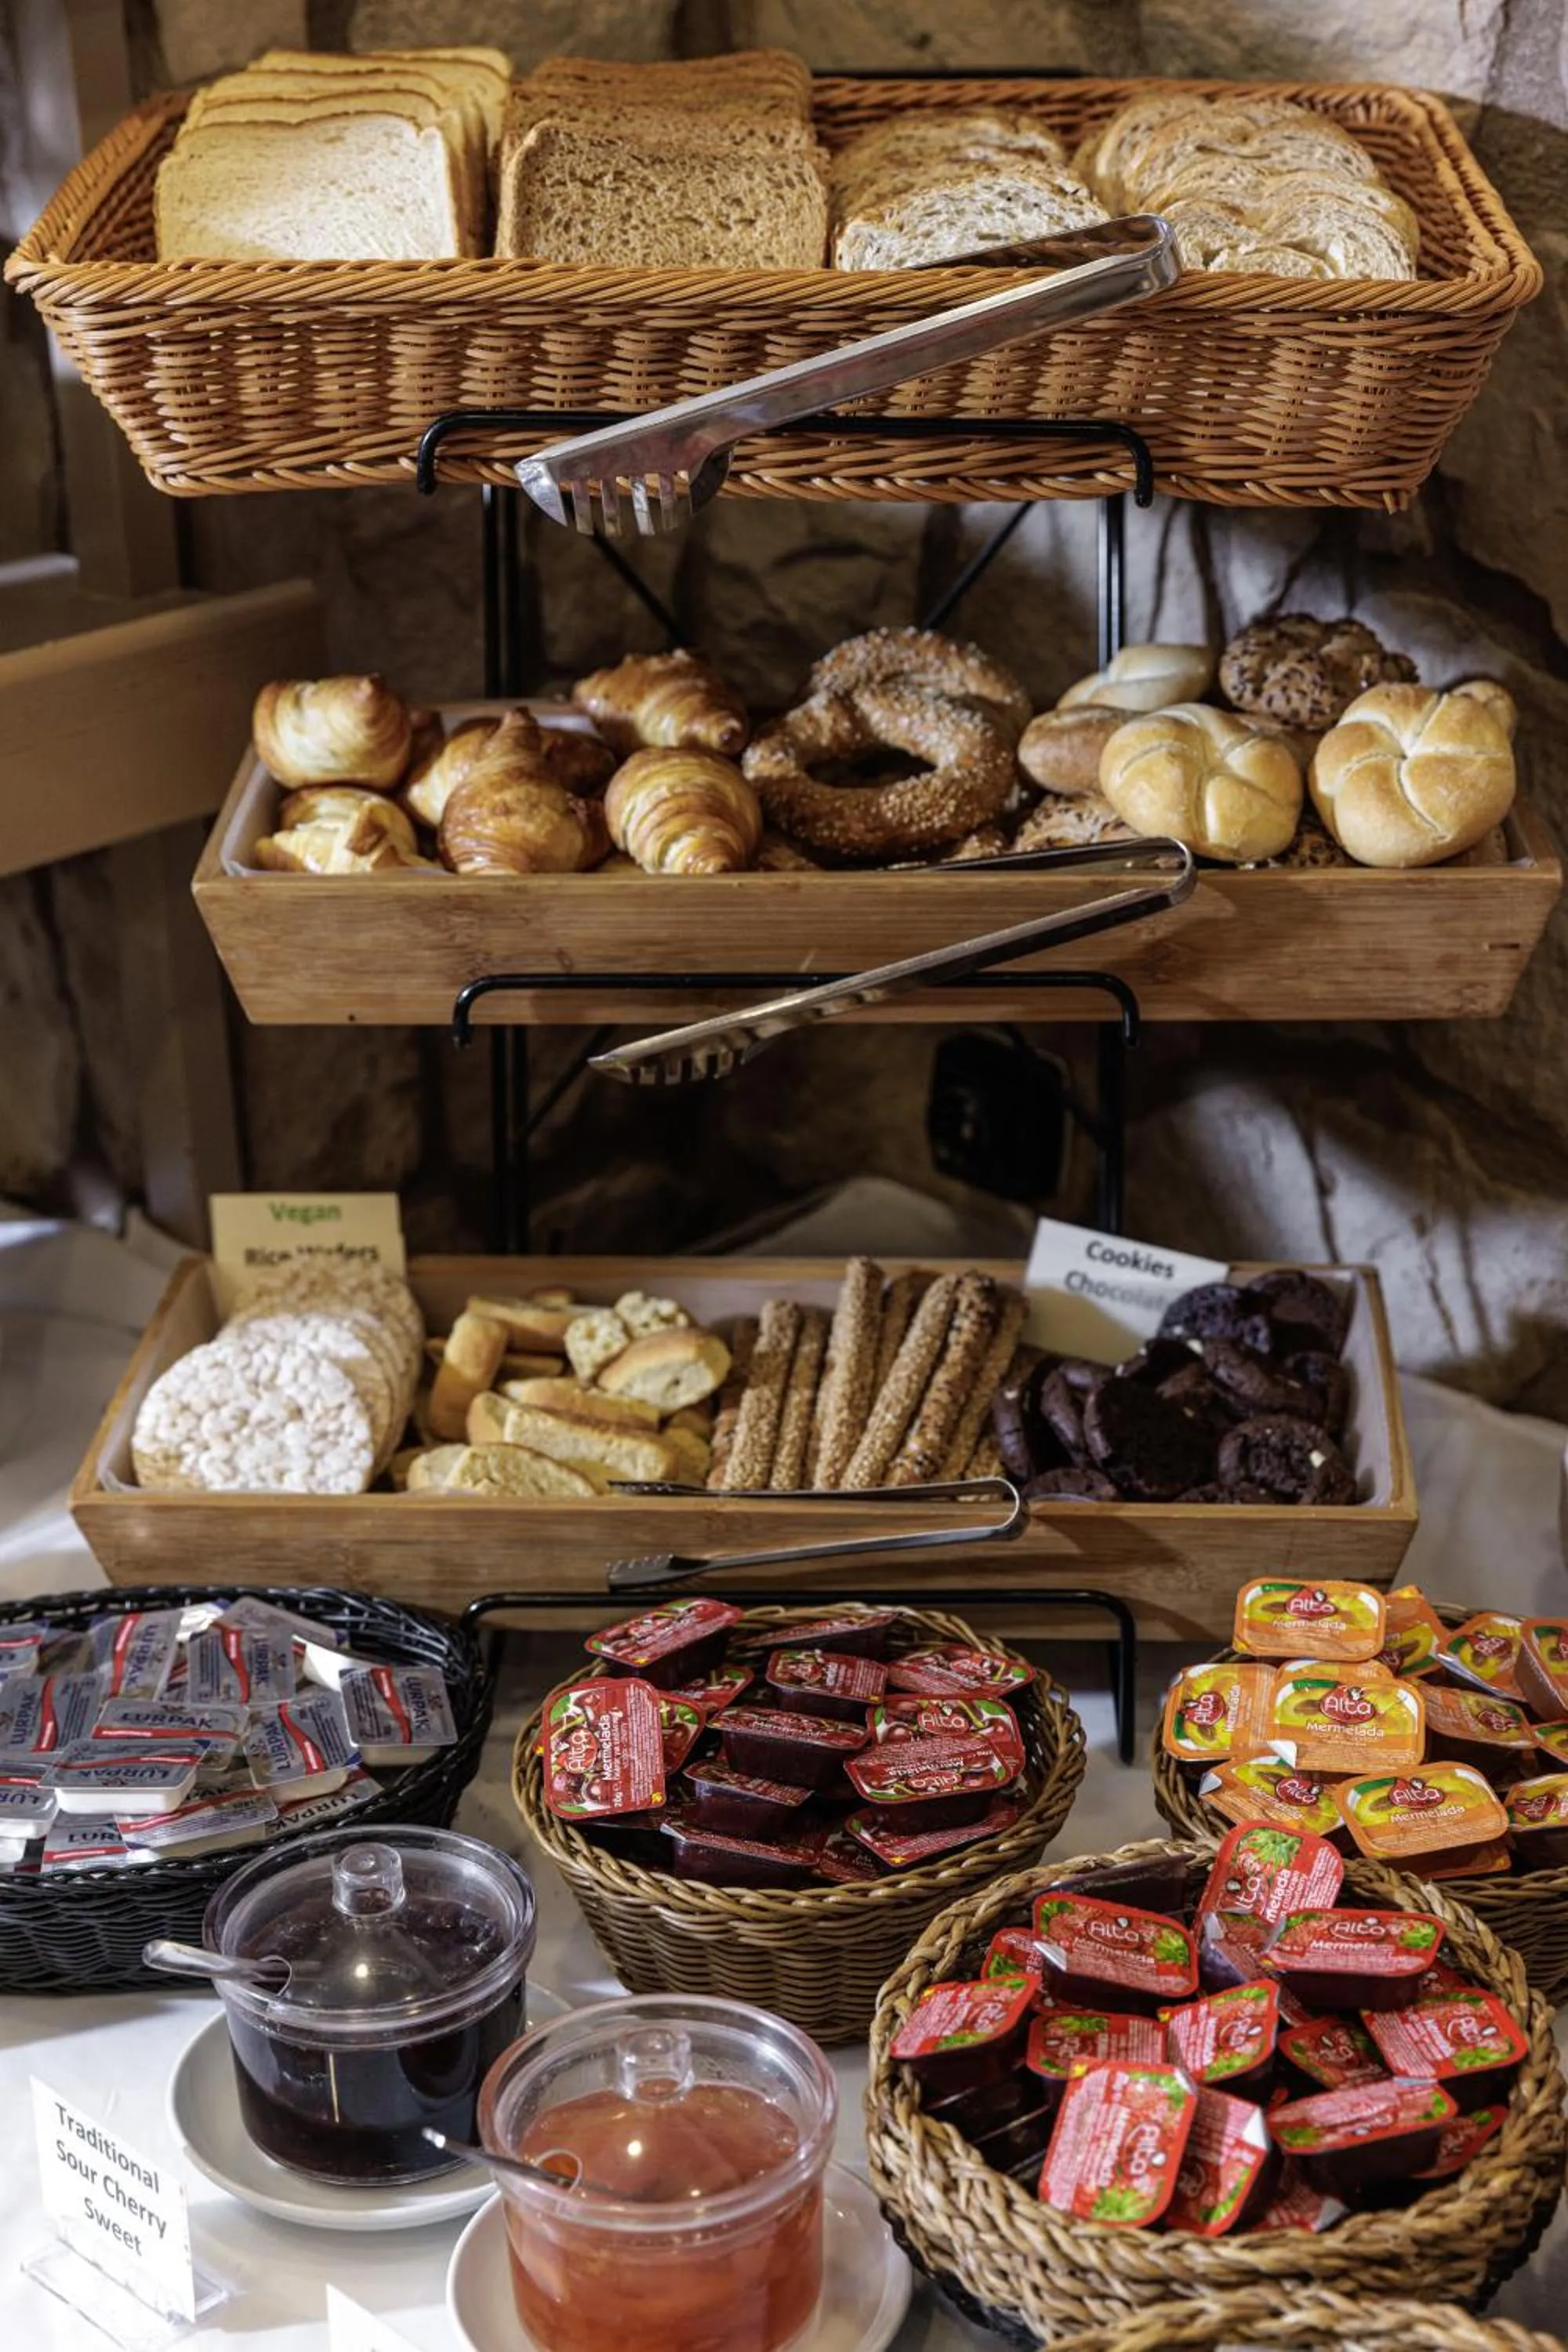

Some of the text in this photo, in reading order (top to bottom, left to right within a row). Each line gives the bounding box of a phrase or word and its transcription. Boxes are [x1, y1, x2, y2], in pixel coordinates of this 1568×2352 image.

[270, 1203, 341, 1224] Vegan
[1086, 1240, 1174, 1279] Cookies
[1064, 1269, 1167, 1312] Chocolat
[1289, 1598, 1335, 1613] Alta
[128, 1624, 159, 1685] LURPAK
[252, 1634, 270, 1686] LURPAK
[10, 1691, 38, 1745] LURPAK
[119, 1712, 213, 1729] LURPAK
[405, 1676, 430, 1730] LURPAK
[921, 1711, 966, 1729] Alta
[1324, 1696, 1371, 1715] Alta
[263, 1719, 292, 1771] LURPAK
[600, 1714, 613, 1781] Mermelada
[1306, 1722, 1385, 1737] Mermelada
[567, 1727, 588, 1772] Alta
[77, 1767, 171, 1780] LURPAK
[909, 1773, 958, 1788] Alta
[1393, 1788, 1441, 1803] Alta
[1390, 1805, 1466, 1824] Mermelada
[68, 1831, 122, 1844] LUR
[1236, 1875, 1261, 1910] lta
[1265, 1868, 1292, 1924] melada
[1090, 1921, 1139, 1943] Alta
[1334, 1921, 1386, 1936] Alta
[54, 2102, 159, 2194] Traditional
[1129, 2122, 1161, 2177] Alta
[56, 2139, 167, 2240] Sour Cherry
[84, 2196, 143, 2256] Sweet
